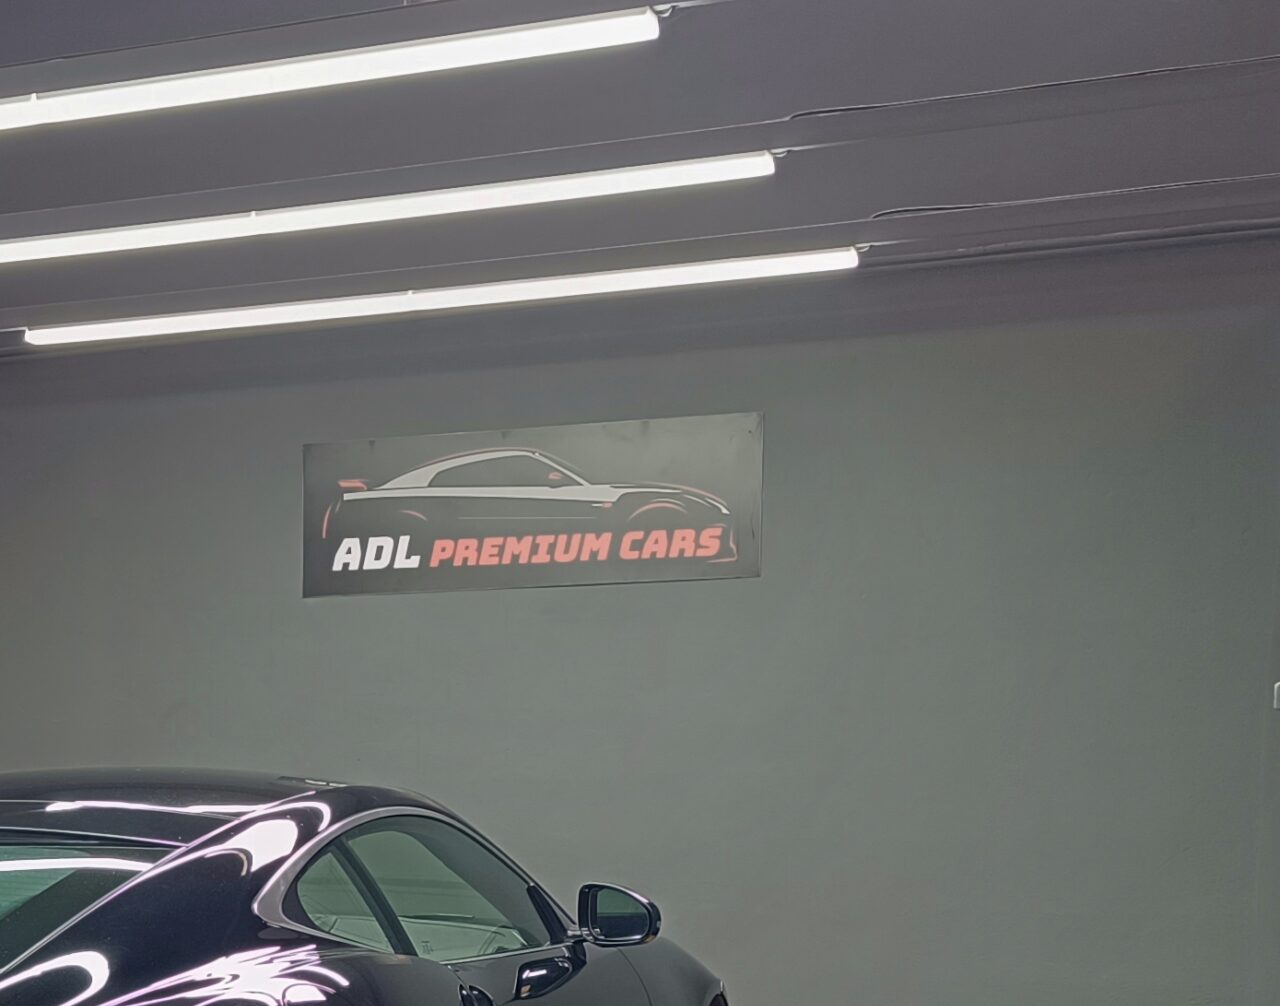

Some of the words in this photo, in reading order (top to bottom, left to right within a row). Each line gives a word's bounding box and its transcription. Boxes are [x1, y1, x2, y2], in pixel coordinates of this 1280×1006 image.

[331, 535, 421, 571] ADL
[429, 532, 613, 567] PREMIUM
[619, 527, 723, 560] CARS
